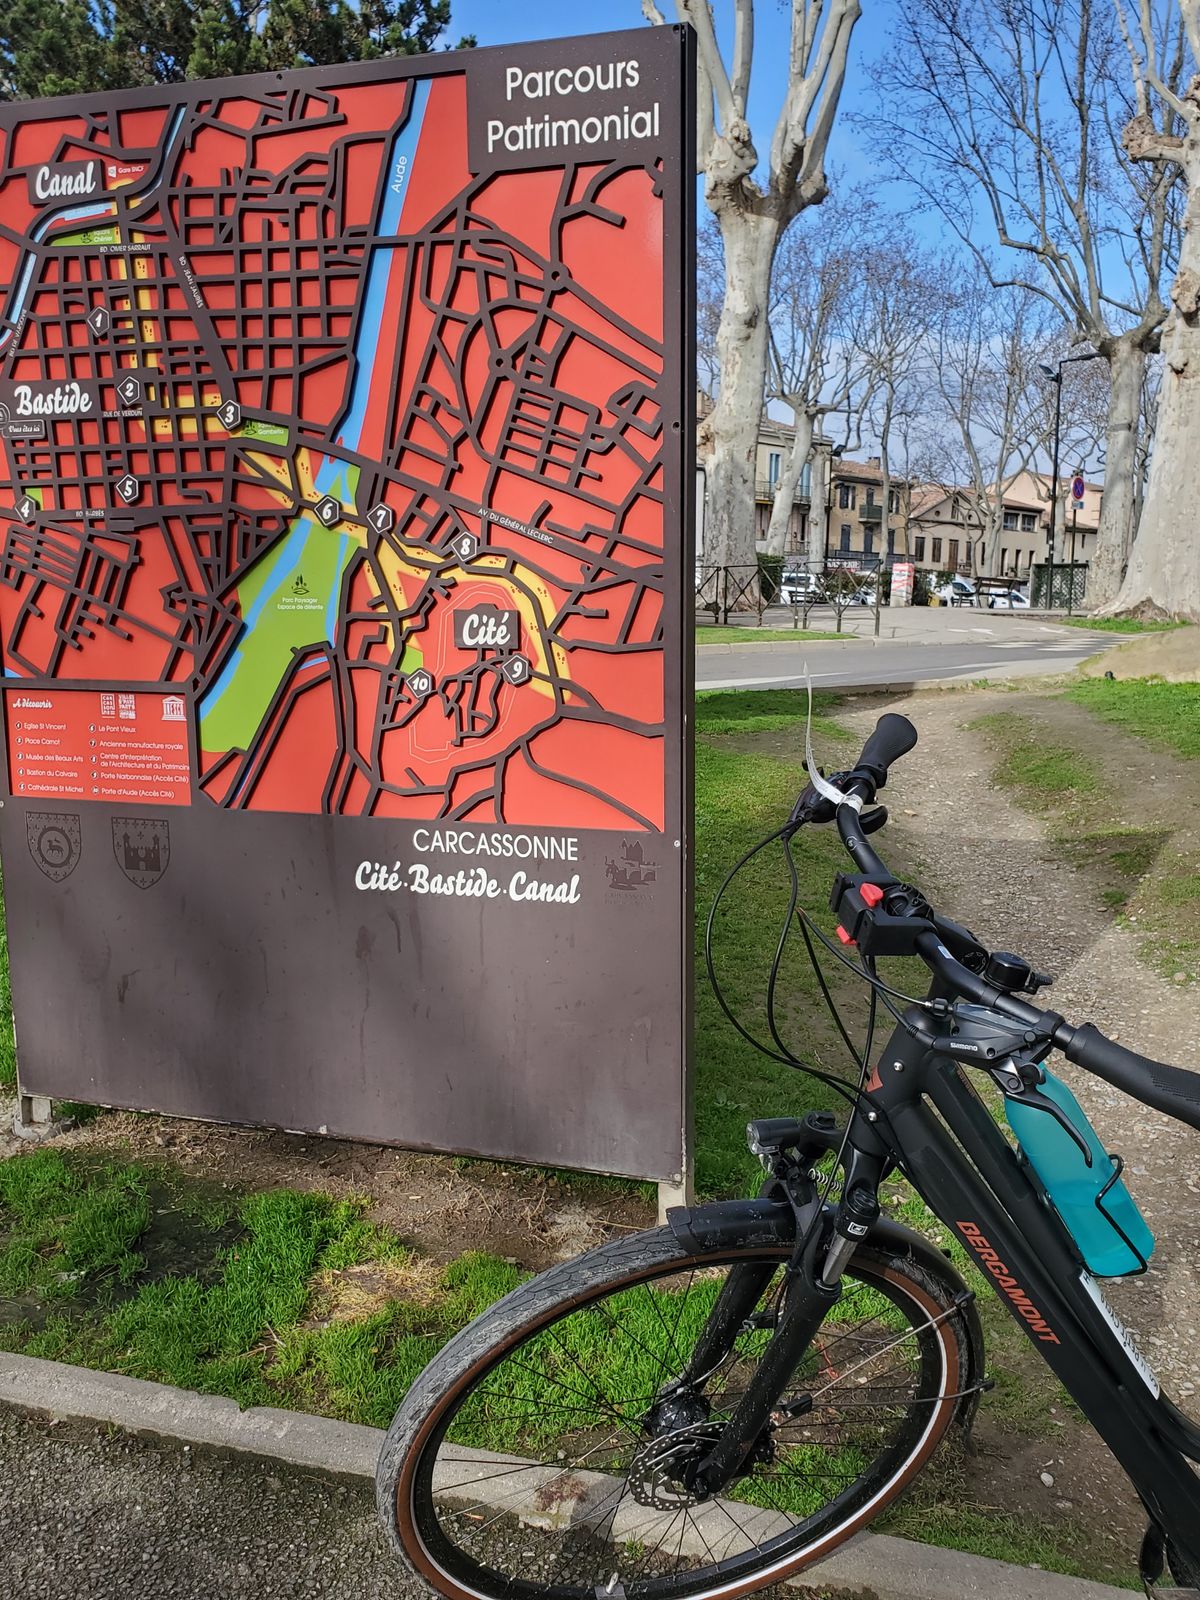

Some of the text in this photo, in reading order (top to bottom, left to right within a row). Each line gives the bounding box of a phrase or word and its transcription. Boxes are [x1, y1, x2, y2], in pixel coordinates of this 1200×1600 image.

[505, 59, 640, 101] Parcours
[487, 102, 660, 153] Patrimonial
[35, 161, 97, 200] Canal
[391, 156, 408, 193] Aude
[94, 312, 103, 328] 1
[14, 382, 92, 416] Bastide
[125, 383, 134, 397] 2
[224, 405, 235, 423] 3
[124, 480, 133, 497] 5
[20, 500, 30, 518] 4
[322, 503, 334, 520] 6
[376, 510, 387, 528] 7
[489, 512, 500, 521] DU
[500, 516, 527, 534] GÉNÉRAL
[527, 528, 554, 544] LECLERC
[461, 537, 471, 555] 8
[462, 611, 511, 646] Cité
[512, 661, 523, 678] 9
[411, 676, 428, 690] 10
[99, 752, 119, 760] Centre
[412, 828, 579, 861] CARCASSONNE
[508, 871, 581, 904] Canal
[950, 1042, 978, 1052] SHIMANO
[956, 1220, 1061, 1345] BERGAMONT
